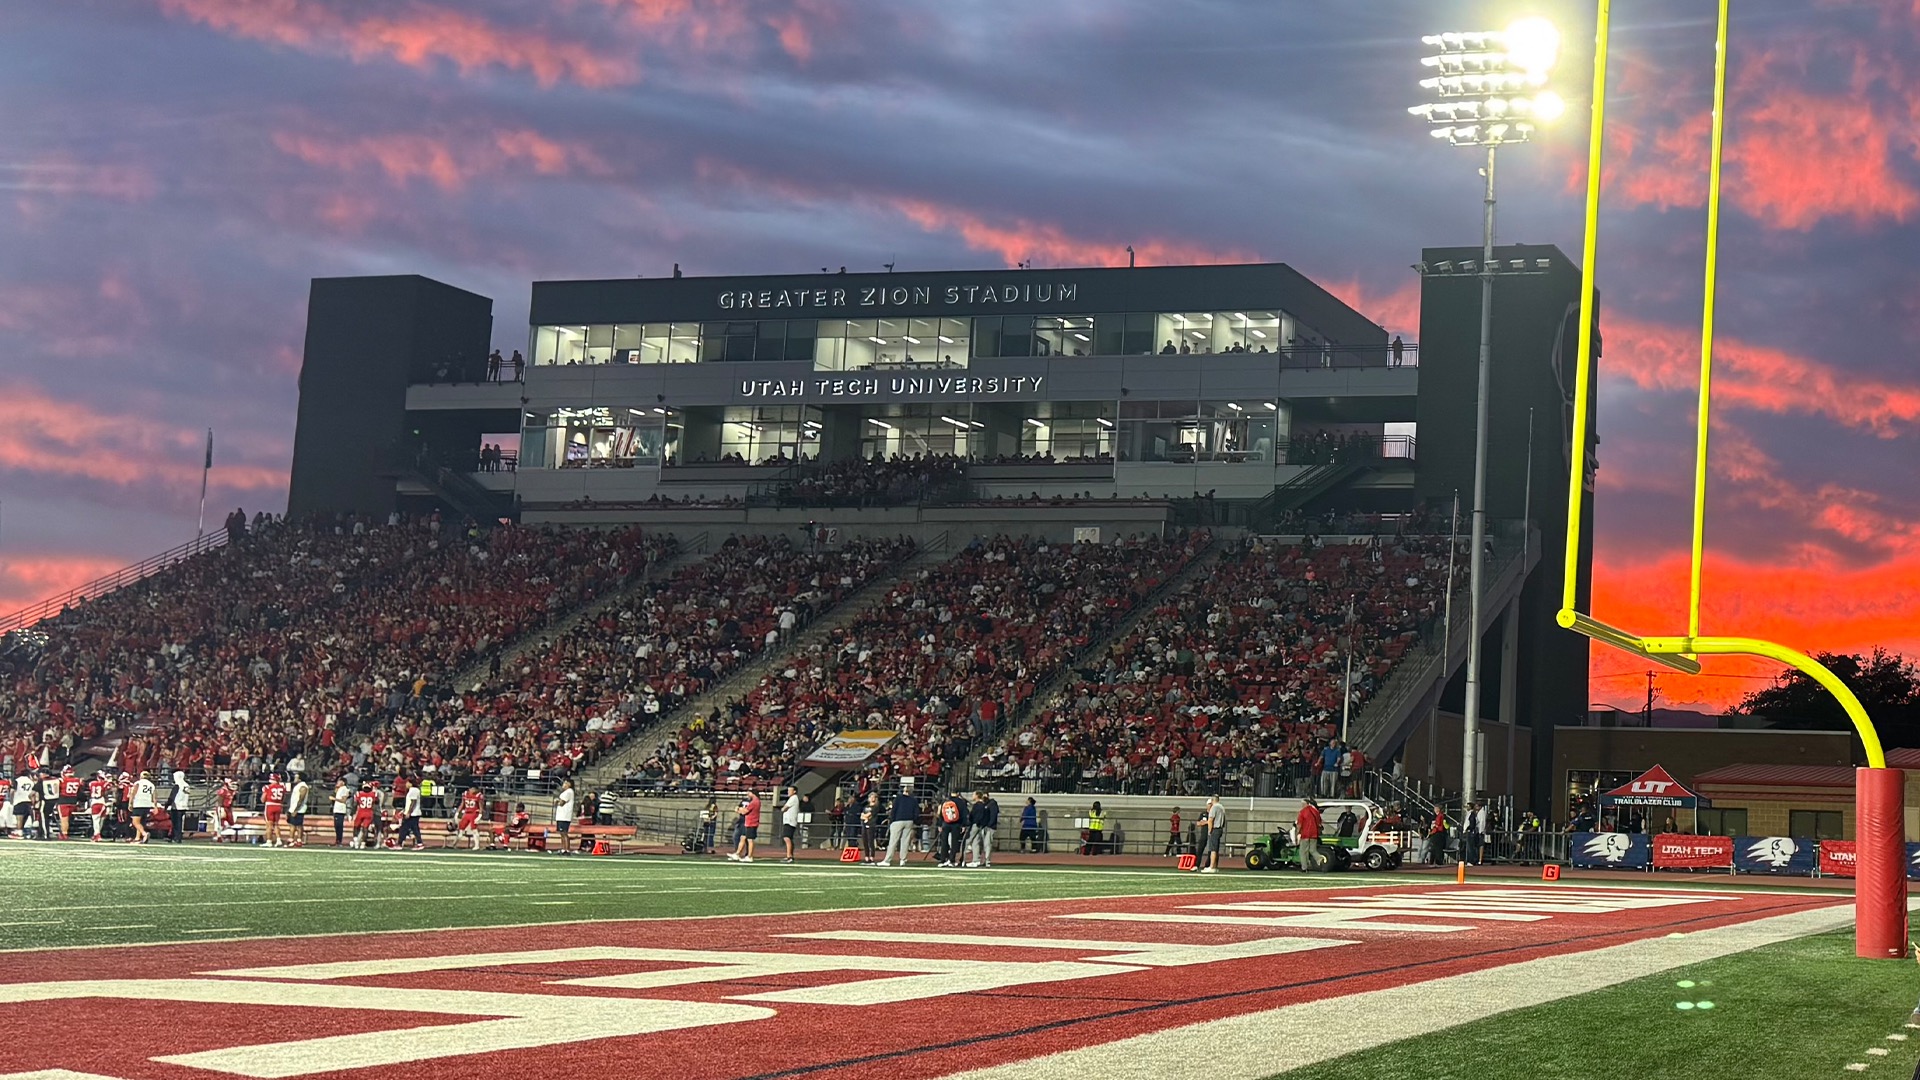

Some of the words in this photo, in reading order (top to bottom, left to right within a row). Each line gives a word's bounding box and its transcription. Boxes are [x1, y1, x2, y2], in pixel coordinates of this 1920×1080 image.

[718, 288, 847, 310] GREATER
[859, 286, 931, 307] ZION
[943, 283, 1078, 304] STADIUM
[740, 380, 805, 398] UTAH
[814, 378, 879, 397] TECH
[889, 375, 1043, 395] UNIVERSITY
[21, 783, 32, 792] 47
[65, 781, 79, 794] 65
[91, 785, 103, 798] 13
[270, 787, 284, 800] 35
[359, 797, 373, 809] 38
[1613, 798, 1662, 806] TRAILBLAZER
[1662, 799, 1683, 807] CLUB
[842, 848, 855, 860] 20
[1661, 845, 1691, 855] UTAH
[1693, 846, 1723, 855] TECH
[1181, 855, 1193, 868] 10
[1829, 851, 1857, 862] UTAH
[1545, 866, 1556, 878] G
